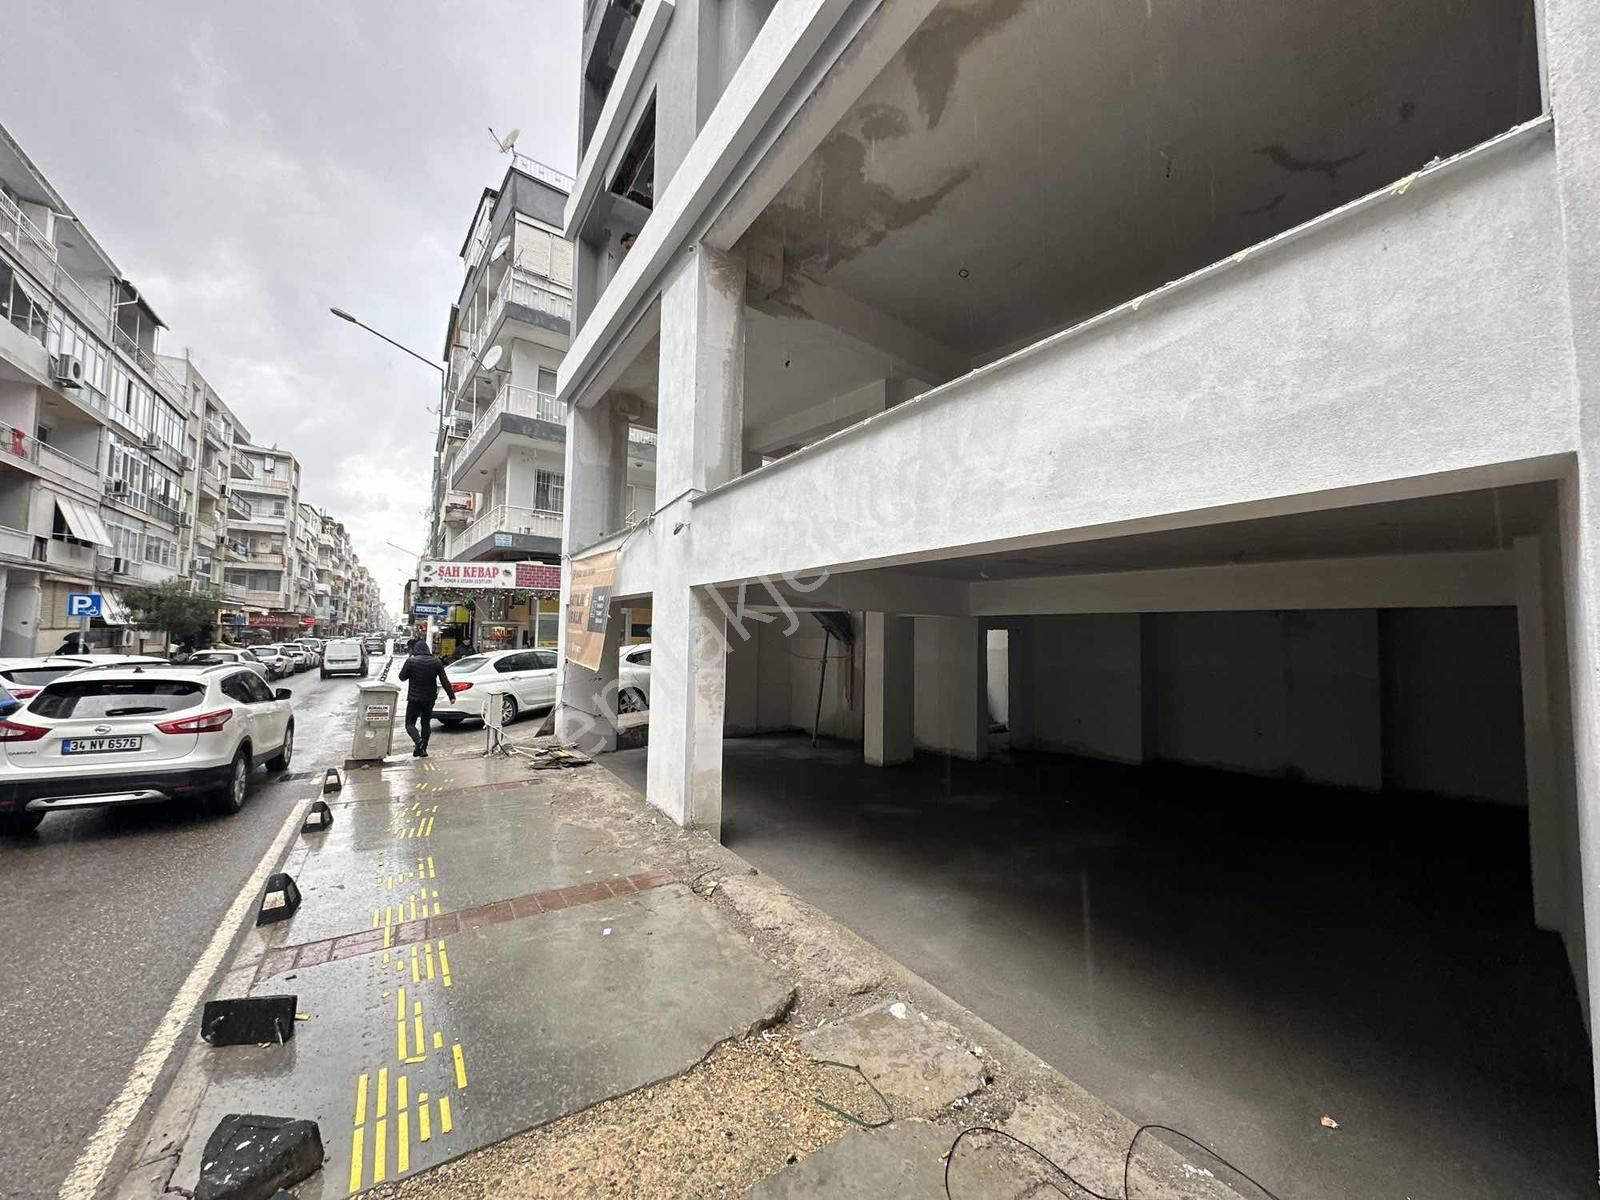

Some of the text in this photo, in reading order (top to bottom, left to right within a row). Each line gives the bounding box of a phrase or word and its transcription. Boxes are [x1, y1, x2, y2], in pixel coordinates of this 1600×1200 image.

[438, 566, 500, 581] ŞAH KEBAP
[72, 596, 92, 614] P
[71, 738, 137, 750] 34 NV 6576
